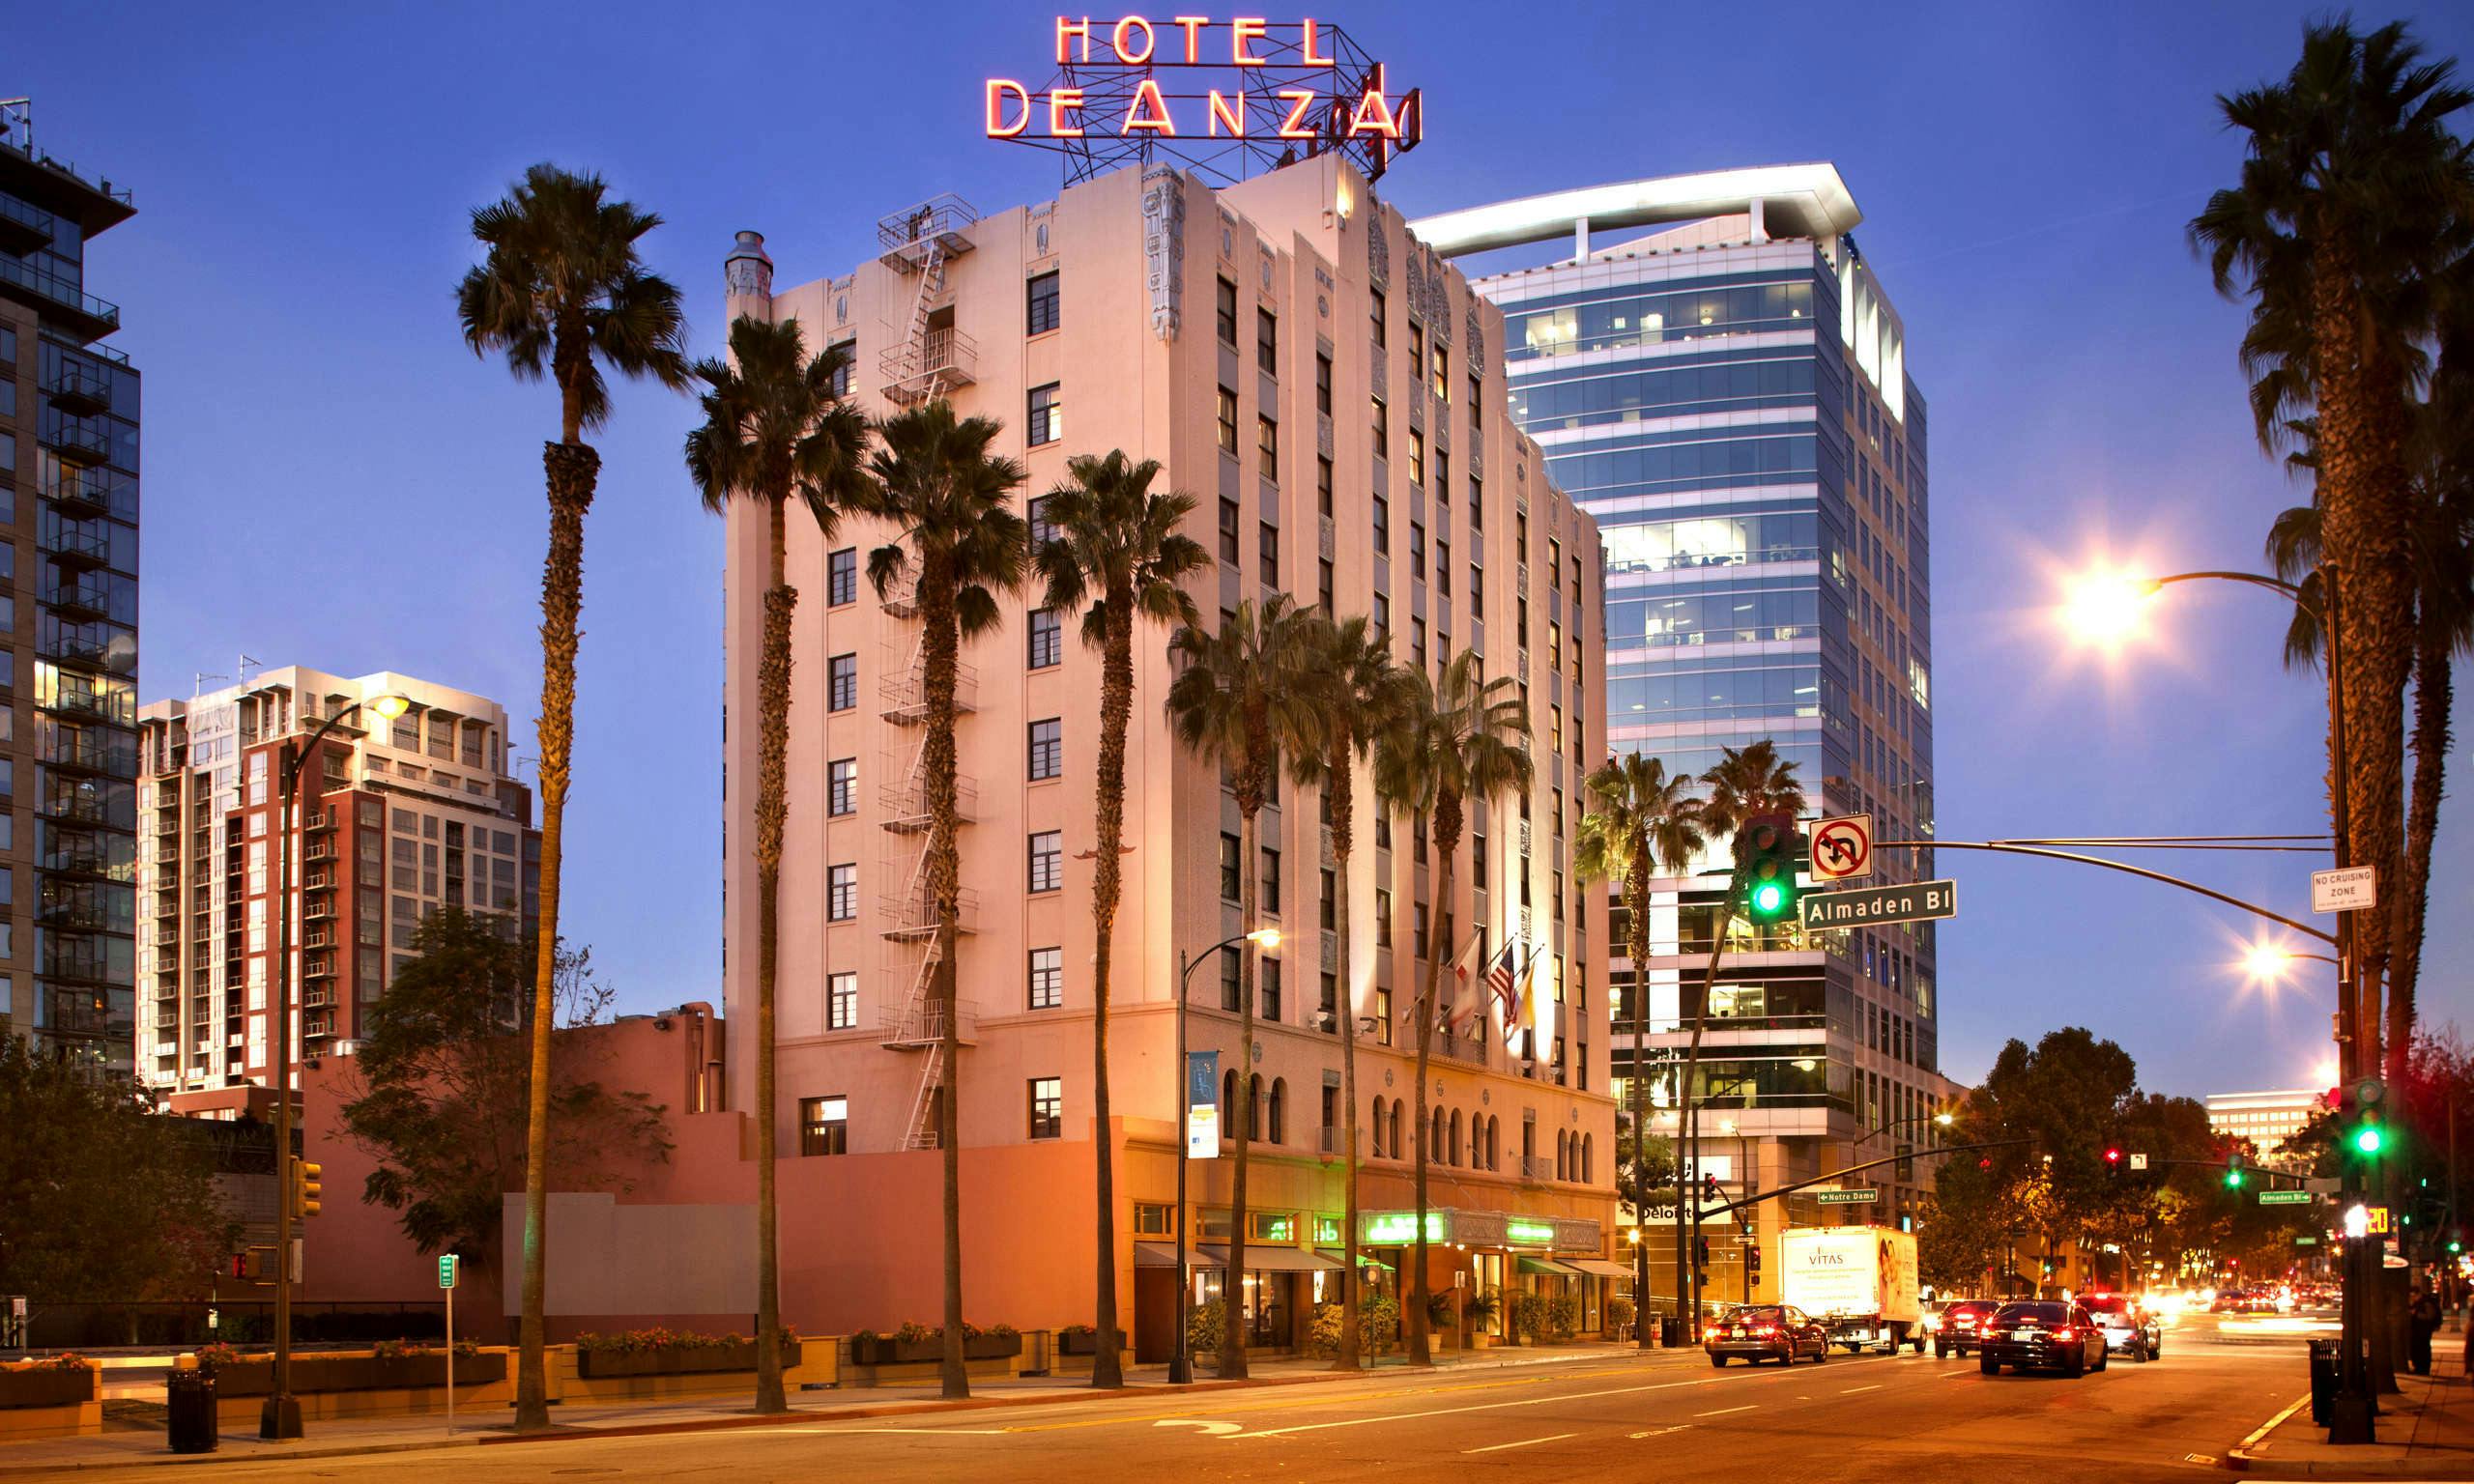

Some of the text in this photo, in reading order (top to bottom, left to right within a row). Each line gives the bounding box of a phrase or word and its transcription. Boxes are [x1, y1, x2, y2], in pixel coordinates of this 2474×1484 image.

[1056, 16, 1335, 65] HOTEL
[2316, 871, 2371, 885] NO CRUISING
[2331, 886, 2355, 897] ZONE
[1809, 897, 1913, 922] Almaden
[2369, 1208, 2388, 1234] 20
[1809, 1247, 1843, 1265] VITAS
